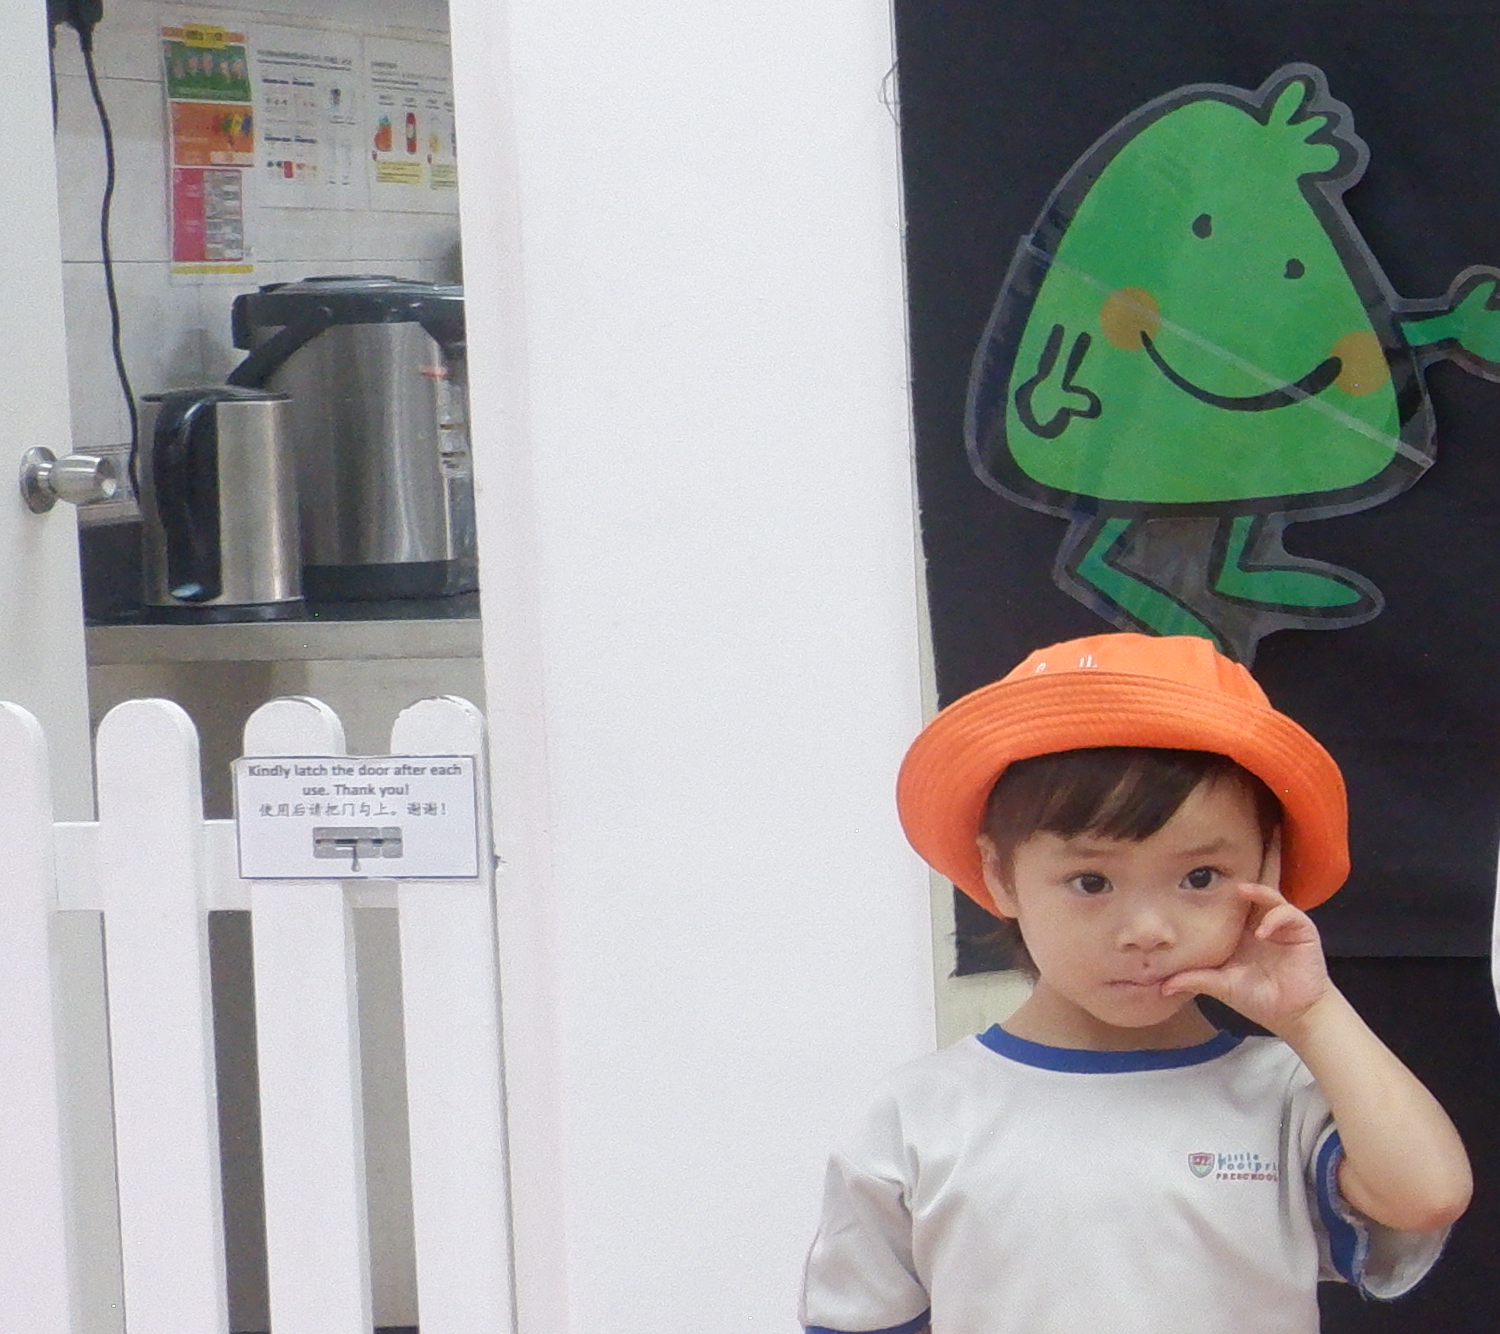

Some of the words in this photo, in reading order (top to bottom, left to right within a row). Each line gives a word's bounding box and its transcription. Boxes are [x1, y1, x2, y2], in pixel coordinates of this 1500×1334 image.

[248, 764, 291, 780] Kindly
[294, 764, 328, 777] latch
[331, 764, 355, 777] the
[358, 763, 390, 776] door
[393, 763, 427, 776] after
[429, 763, 463, 776] each
[302, 786, 330, 797] use.
[333, 784, 377, 797] Thank
[378, 784, 410, 799] you!
